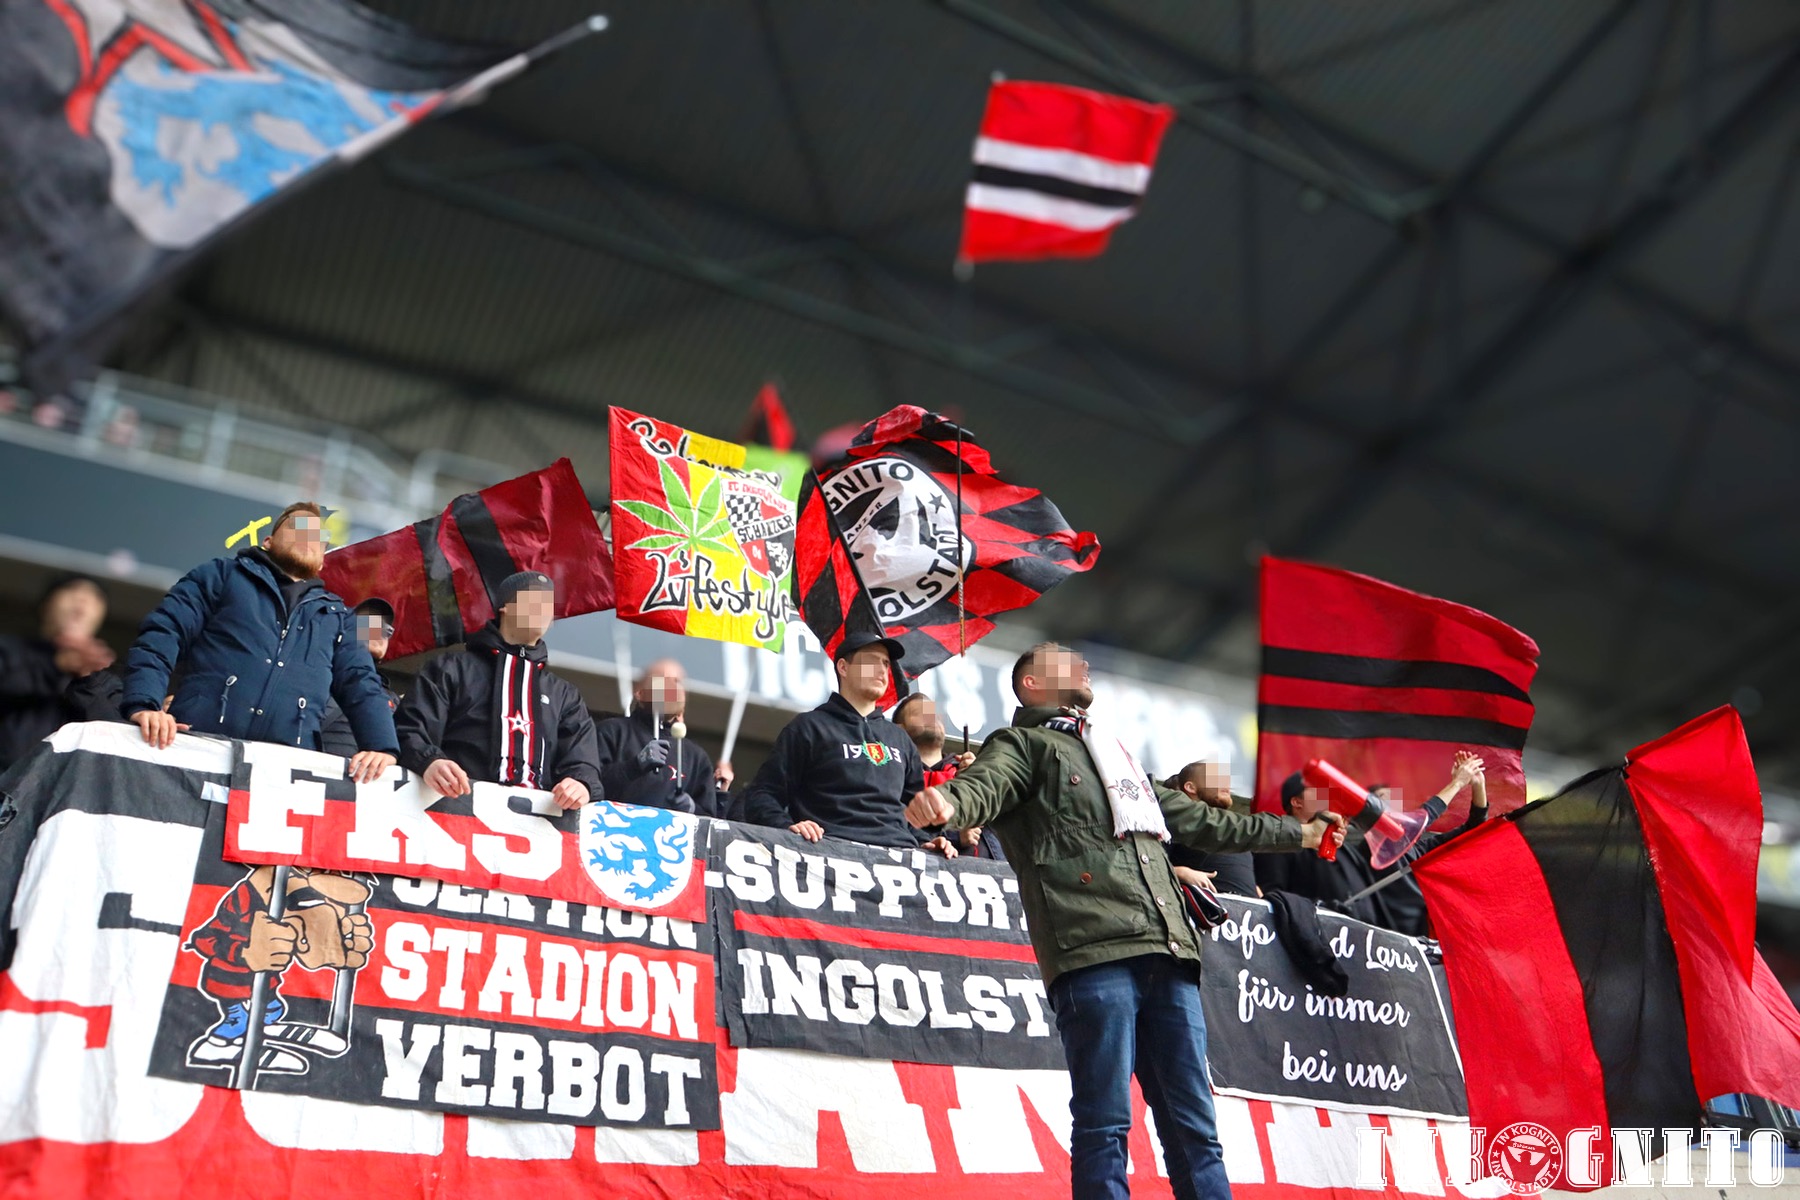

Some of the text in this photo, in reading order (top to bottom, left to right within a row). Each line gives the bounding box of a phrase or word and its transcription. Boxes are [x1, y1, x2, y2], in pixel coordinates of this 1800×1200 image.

[237, 742, 564, 881] FKS
[380, 921, 699, 1040] STADION
[1203, 910, 1276, 960] ofo
[1365, 929, 1418, 973] Lars
[737, 948, 1050, 1038] INGOLST
[1238, 969, 1411, 1028] für immer
[376, 1018, 702, 1126] VERBOT
[1282, 1041, 1408, 1092] bei uns
